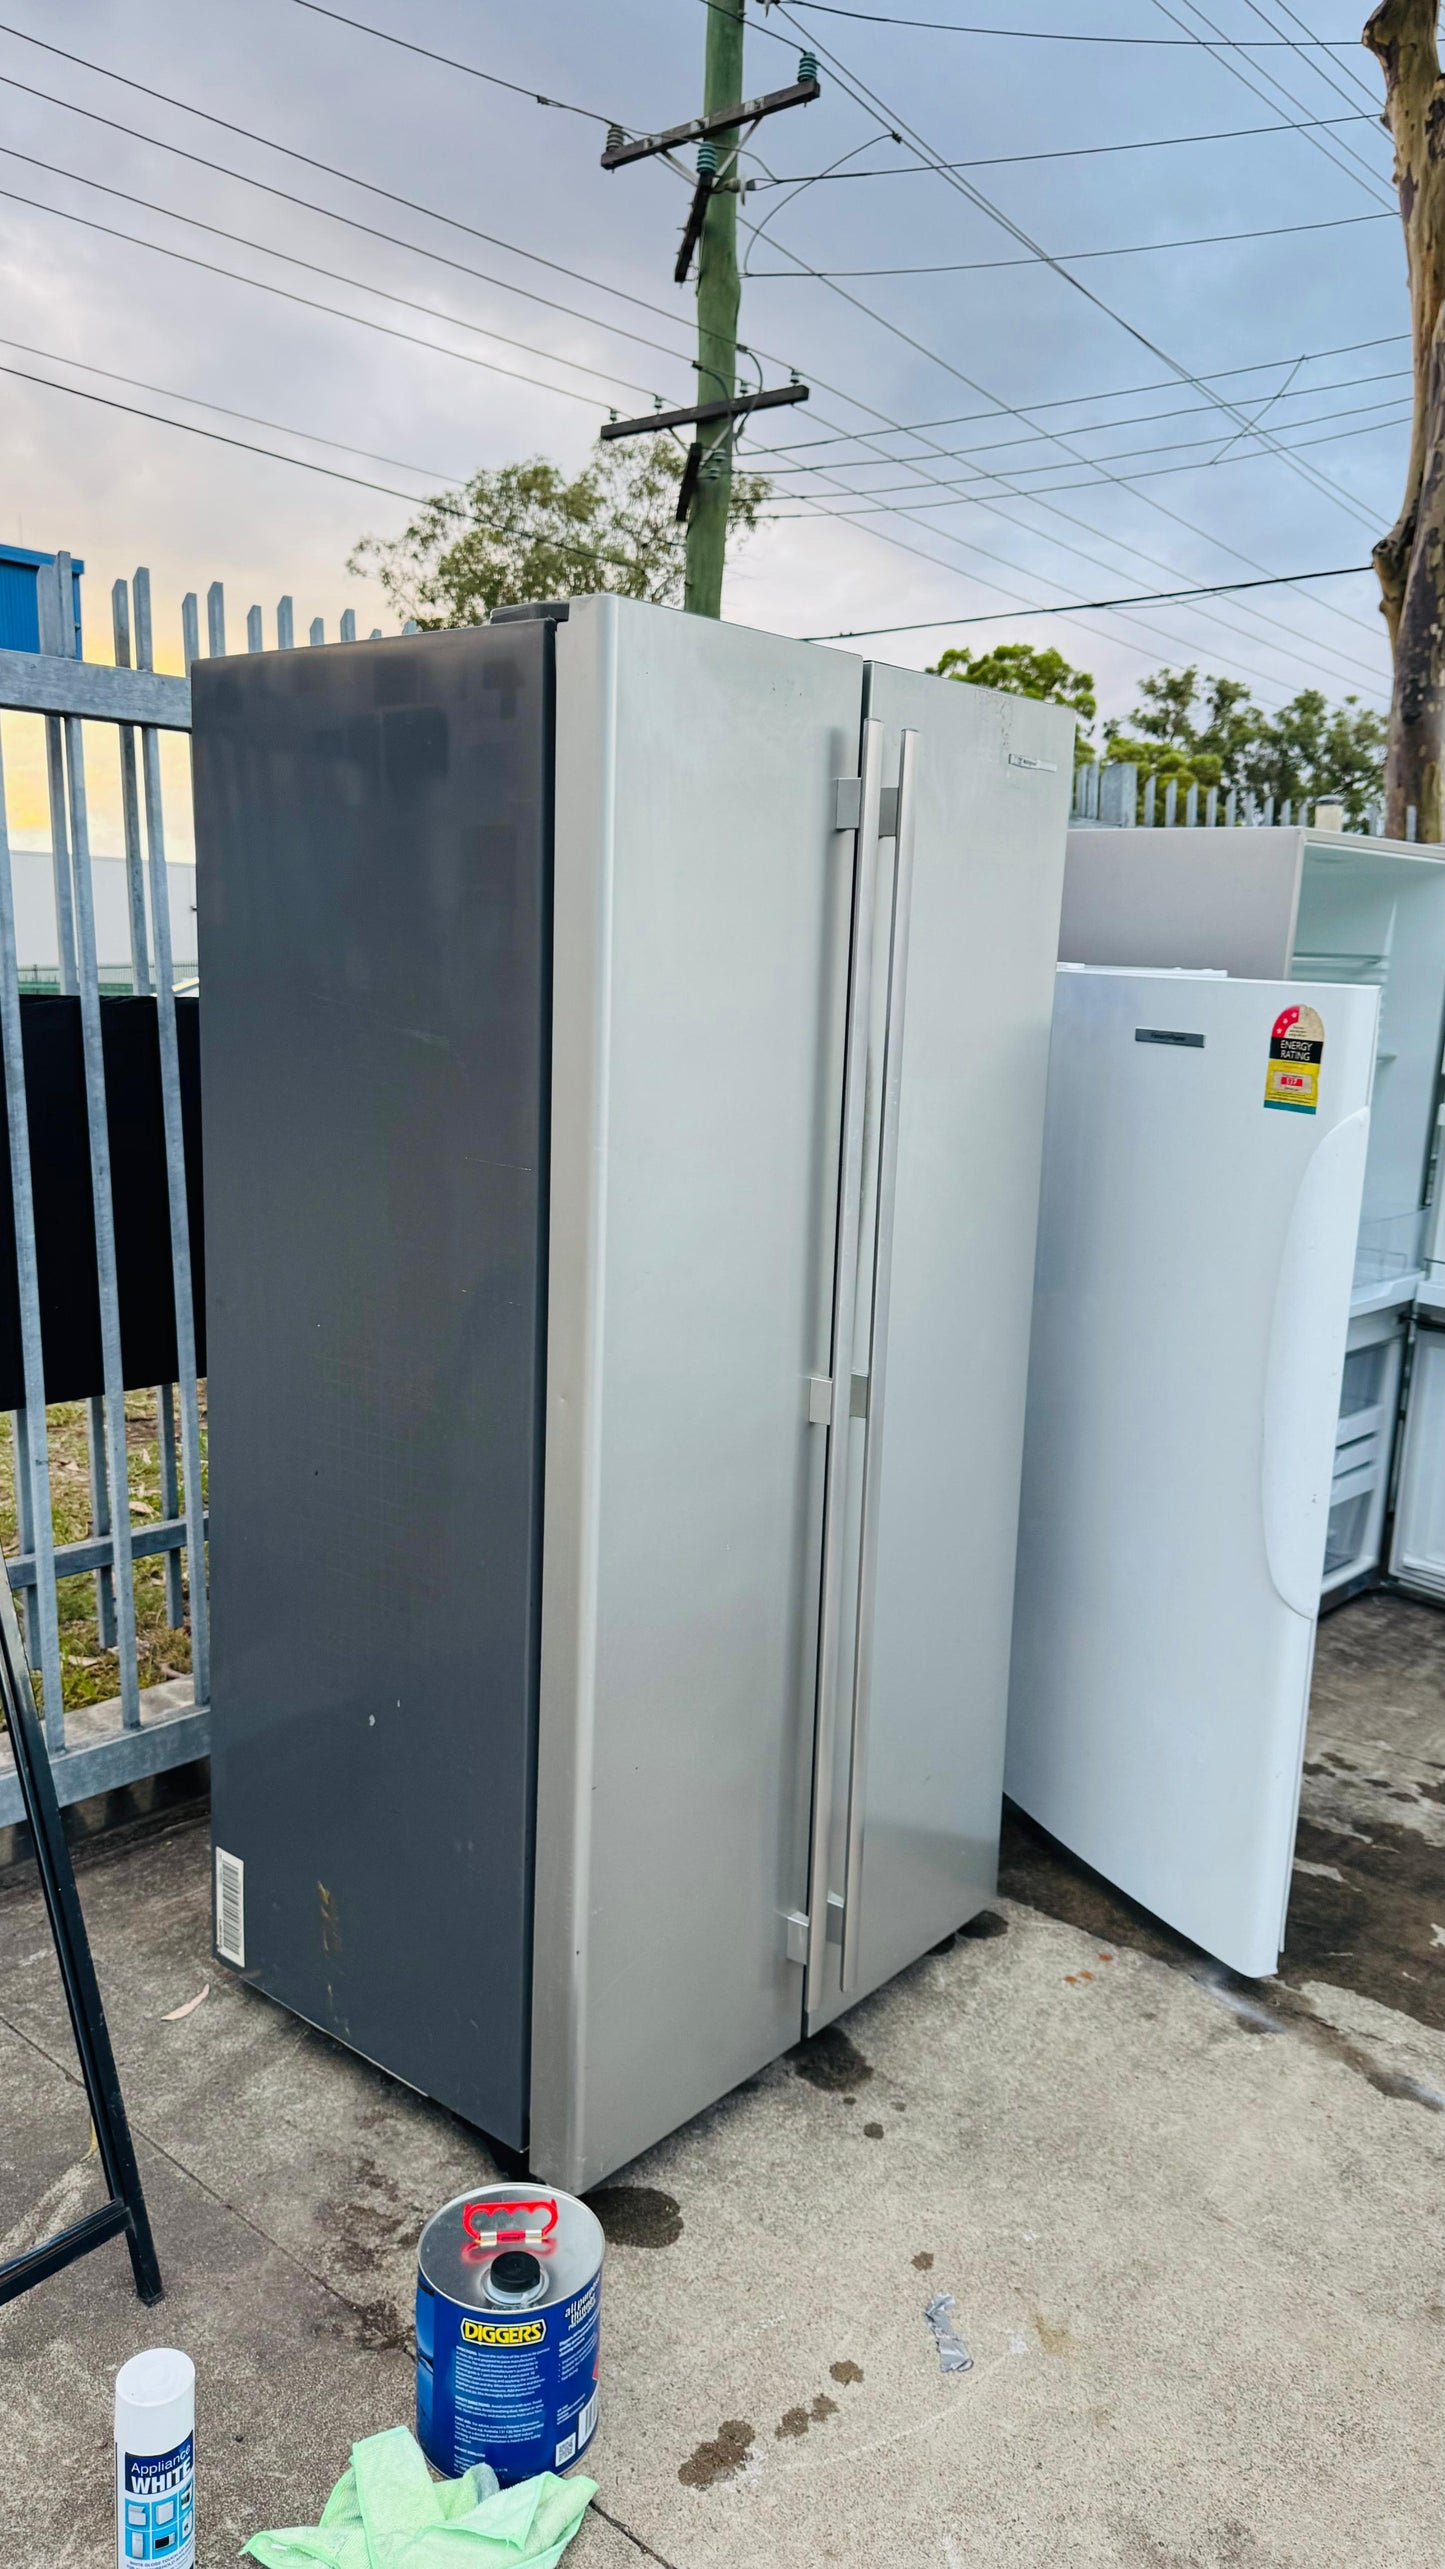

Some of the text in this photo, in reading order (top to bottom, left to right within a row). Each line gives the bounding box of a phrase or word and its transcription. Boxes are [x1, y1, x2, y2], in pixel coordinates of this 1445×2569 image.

[1280, 1040, 1313, 1052] ENERGY
[1280, 1050, 1311, 1061] RATING
[564, 2301, 577, 2318] all
[464, 2321, 542, 2344] DIGGERS
[130, 2444, 192, 2477] Appliance
[131, 2455, 191, 2494] WHITE
